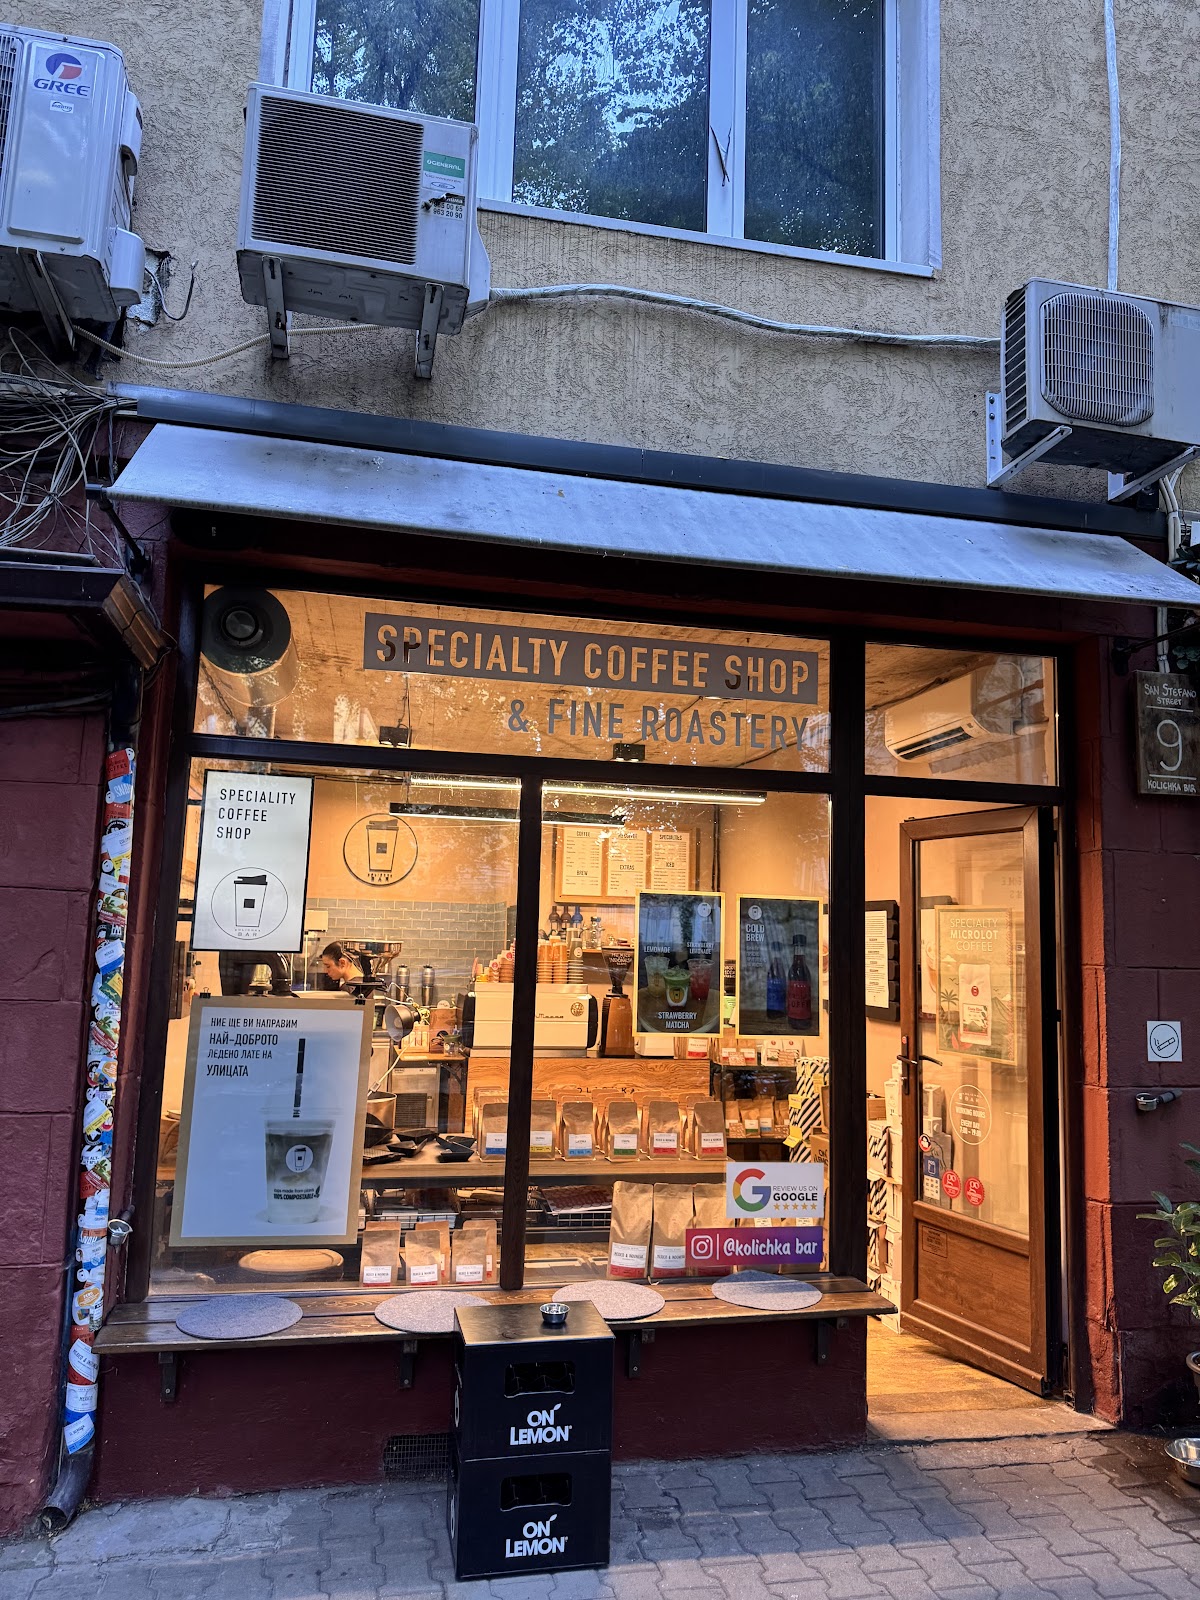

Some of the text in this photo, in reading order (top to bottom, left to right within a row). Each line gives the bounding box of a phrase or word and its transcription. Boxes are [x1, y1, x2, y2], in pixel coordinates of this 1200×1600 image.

[34, 78, 90, 96] GREE
[376, 624, 809, 696] SPECIALTY COFFEE SHOP
[1144, 683, 1196, 698] SAN STEFANO
[508, 698, 809, 751] & FINE ROASTERY
[1156, 720, 1182, 772] 9
[1148, 780, 1196, 794] KOLICHKA BAR
[220, 788, 296, 804] SPECIALITY
[218, 808, 268, 822] COFFEE
[216, 827, 251, 840] SHOP
[746, 924, 764, 933] COLD
[950, 918, 998, 928] SPECIALTY
[746, 934, 764, 942] BREW
[950, 930, 998, 940] MICROLOT
[644, 946, 670, 954] LEMONADE
[956, 941, 992, 952] COFFEE
[658, 1012, 697, 1020] STRAWBERRY
[211, 1018, 298, 1029] НИЕ ЩЕ ВИ НАПРАВИМ
[666, 1021, 690, 1029] MATCHA
[209, 1032, 278, 1046] НАЙ-ДОБРОТО
[208, 1049, 272, 1060] ЛЕДЕНО ЛАТЕ НА
[206, 1064, 249, 1078] УЛИЦАТА
[773, 1192, 818, 1201] GOOGLE
[723, 1238, 818, 1256] @kolichka bar
[527, 1409, 555, 1427] ON
[510, 1426, 570, 1446] LEMON
[522, 1521, 550, 1538] ON
[506, 1536, 566, 1558] LEMON
